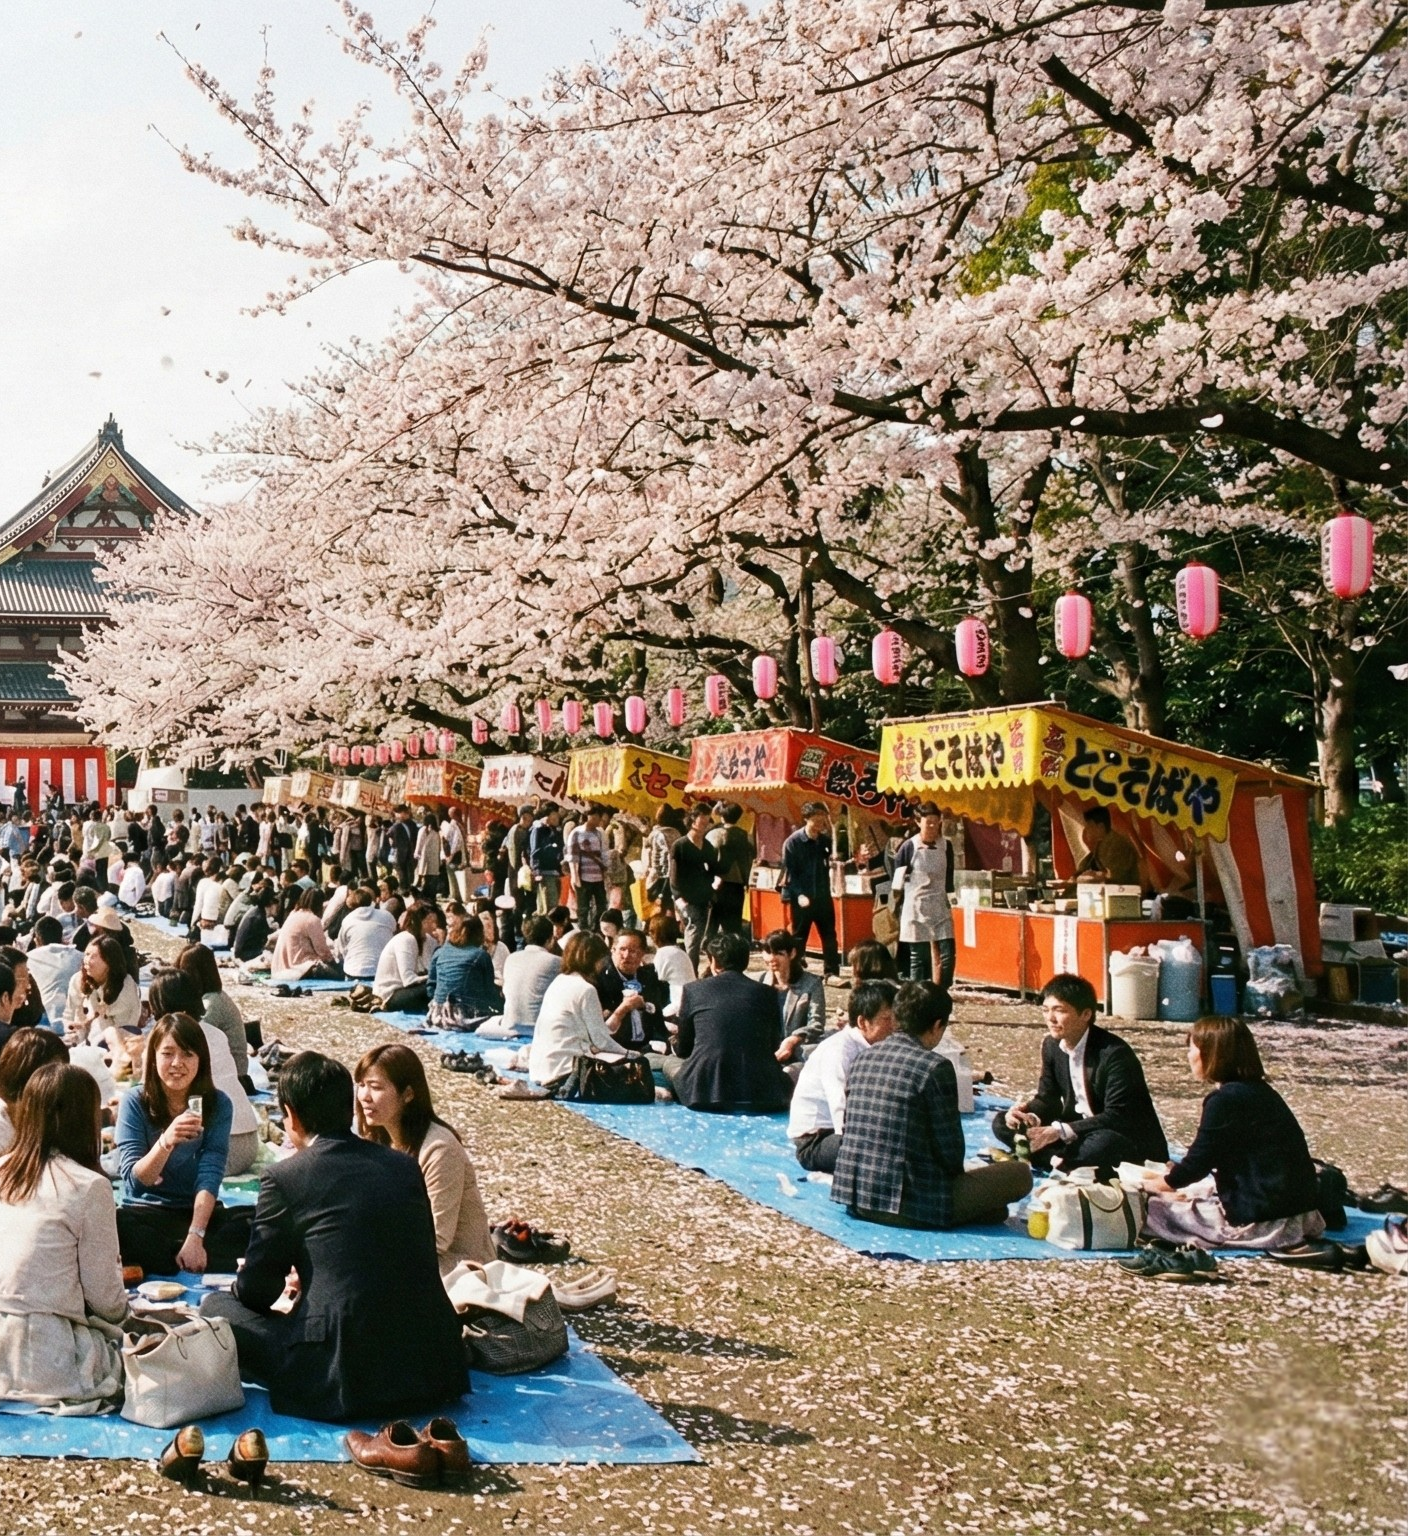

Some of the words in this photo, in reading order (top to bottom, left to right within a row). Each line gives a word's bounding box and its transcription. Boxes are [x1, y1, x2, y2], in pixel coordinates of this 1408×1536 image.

[1064, 737, 1221, 826] とこそばや
